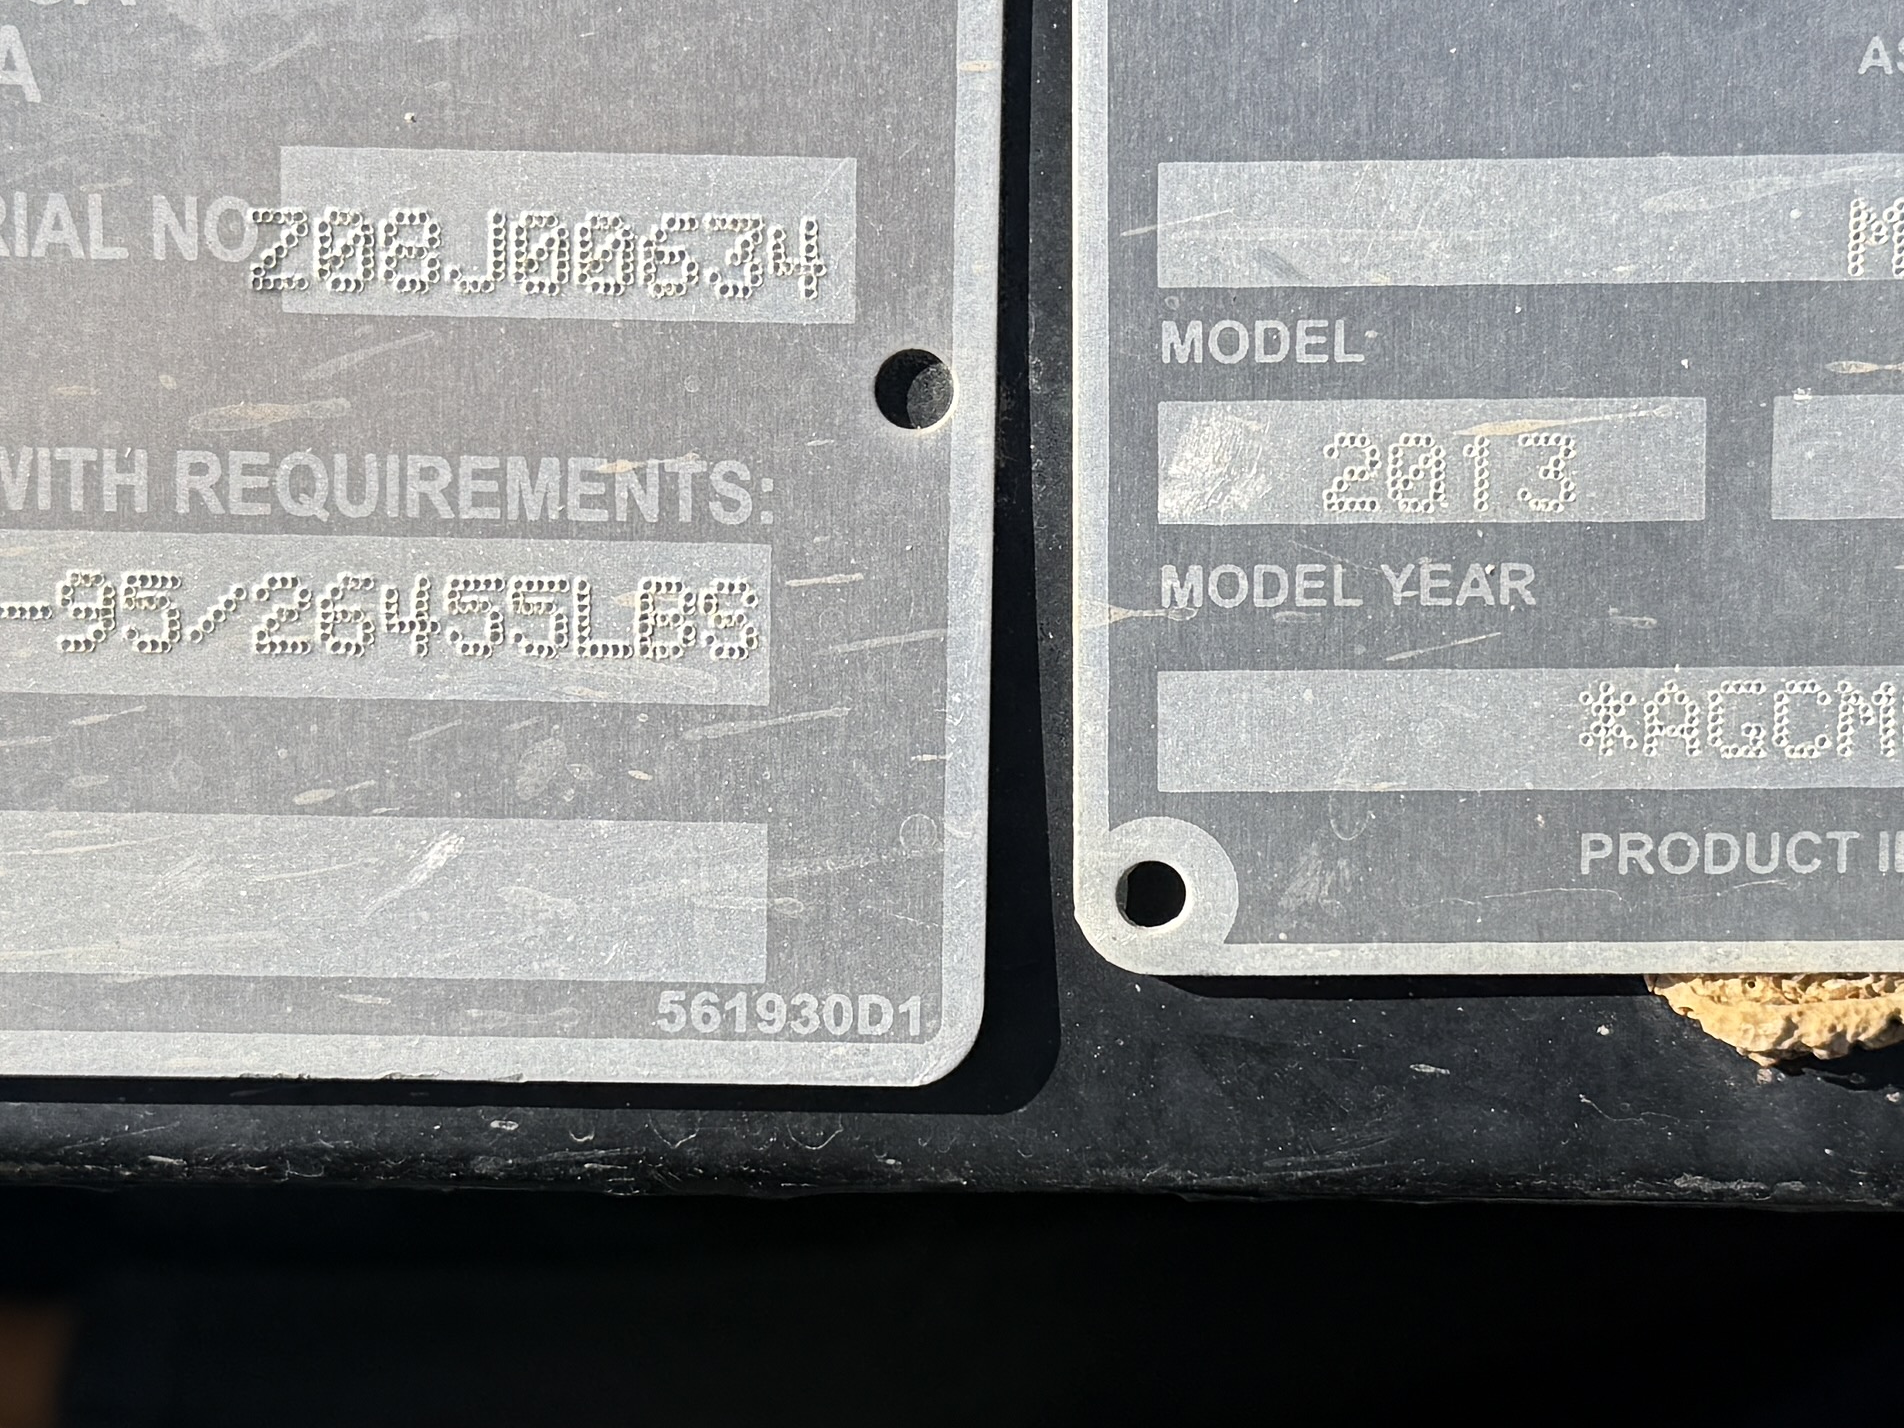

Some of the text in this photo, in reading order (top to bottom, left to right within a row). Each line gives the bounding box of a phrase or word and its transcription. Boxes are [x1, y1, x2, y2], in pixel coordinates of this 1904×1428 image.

[1160, 319, 1366, 366] MODEL
[178, 448, 776, 526] REQUIREMENTS:
[1320, 431, 1578, 516] 2013
[1160, 562, 1538, 609] MODEL YEAR
[1580, 830, 1861, 877] PRODUCT
[656, 989, 926, 1040] 561930D1
